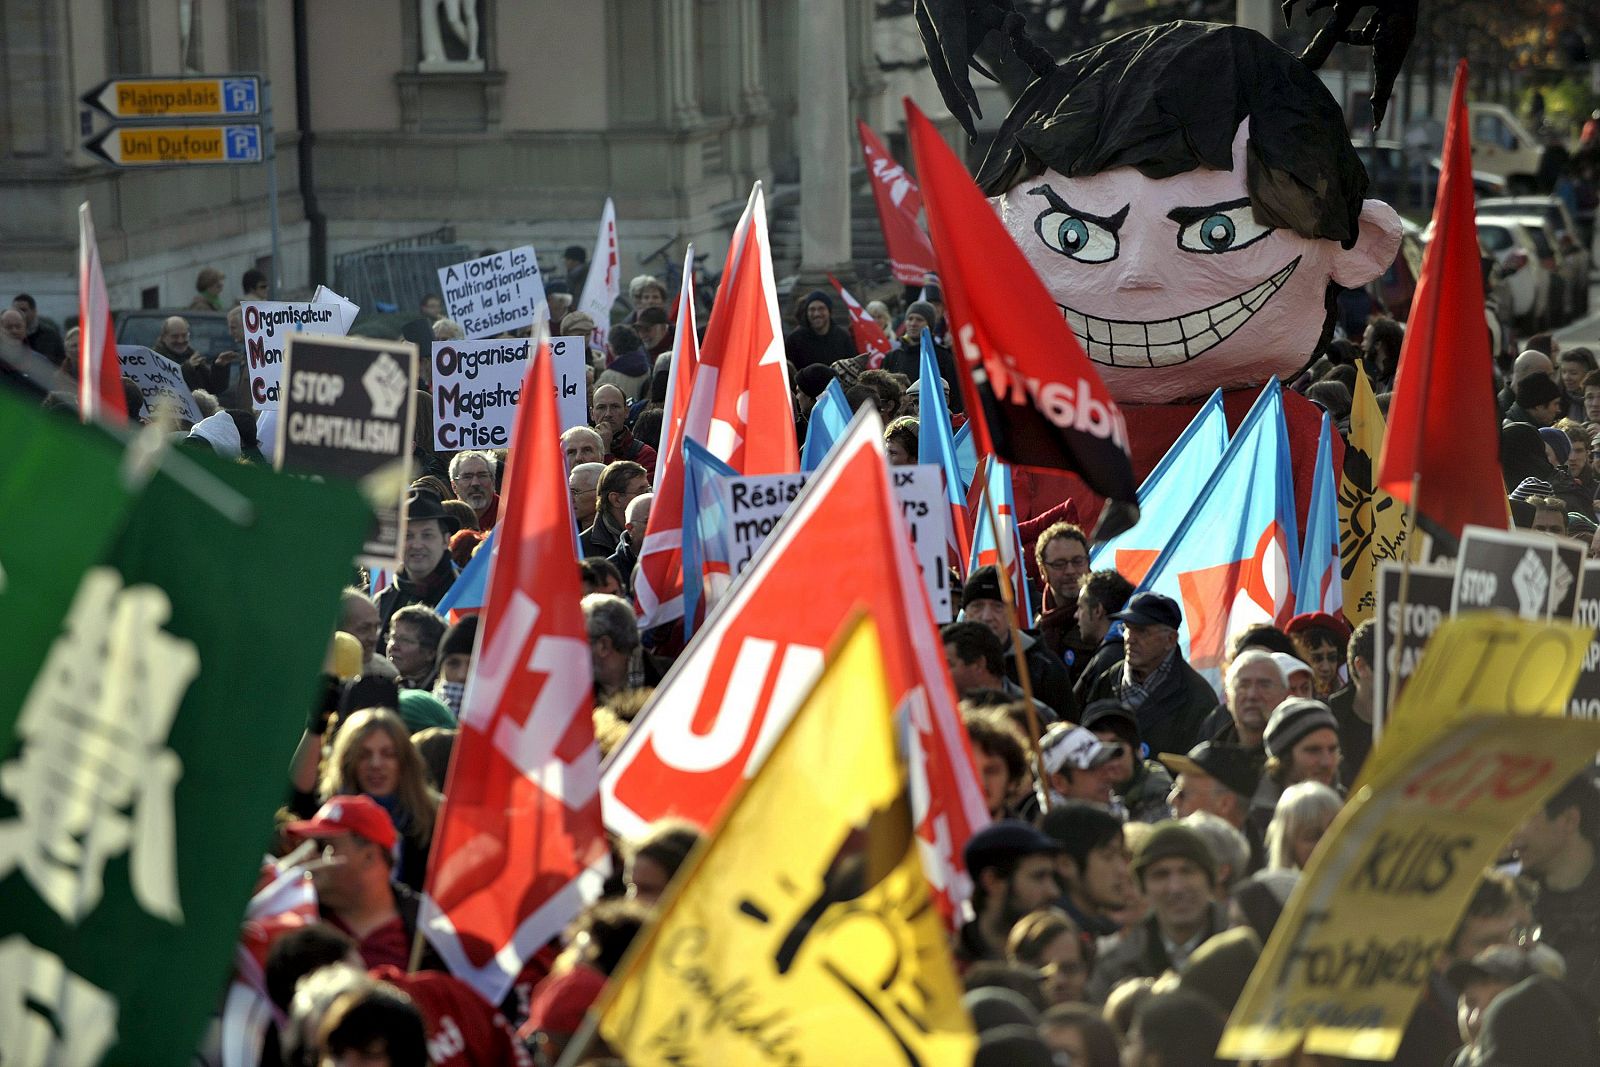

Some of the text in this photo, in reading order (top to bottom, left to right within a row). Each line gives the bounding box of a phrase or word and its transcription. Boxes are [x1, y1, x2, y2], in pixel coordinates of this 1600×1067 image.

[118, 88, 218, 110] Plainpalais
[123, 138, 152, 155] Uni
[157, 136, 221, 154] Dufour
[446, 267, 459, 285] A
[510, 251, 527, 267] les
[446, 264, 538, 304] multinationales
[245, 304, 332, 337] Organisateur
[451, 300, 474, 323] font
[481, 295, 493, 309] la
[496, 289, 511, 305] loi
[290, 370, 345, 406] STOP
[562, 374, 577, 398] la
[288, 412, 401, 455] CAPITALISM
[438, 422, 508, 449] Crise
[1459, 567, 1498, 606] STOP
[1387, 600, 1443, 637] STOP
